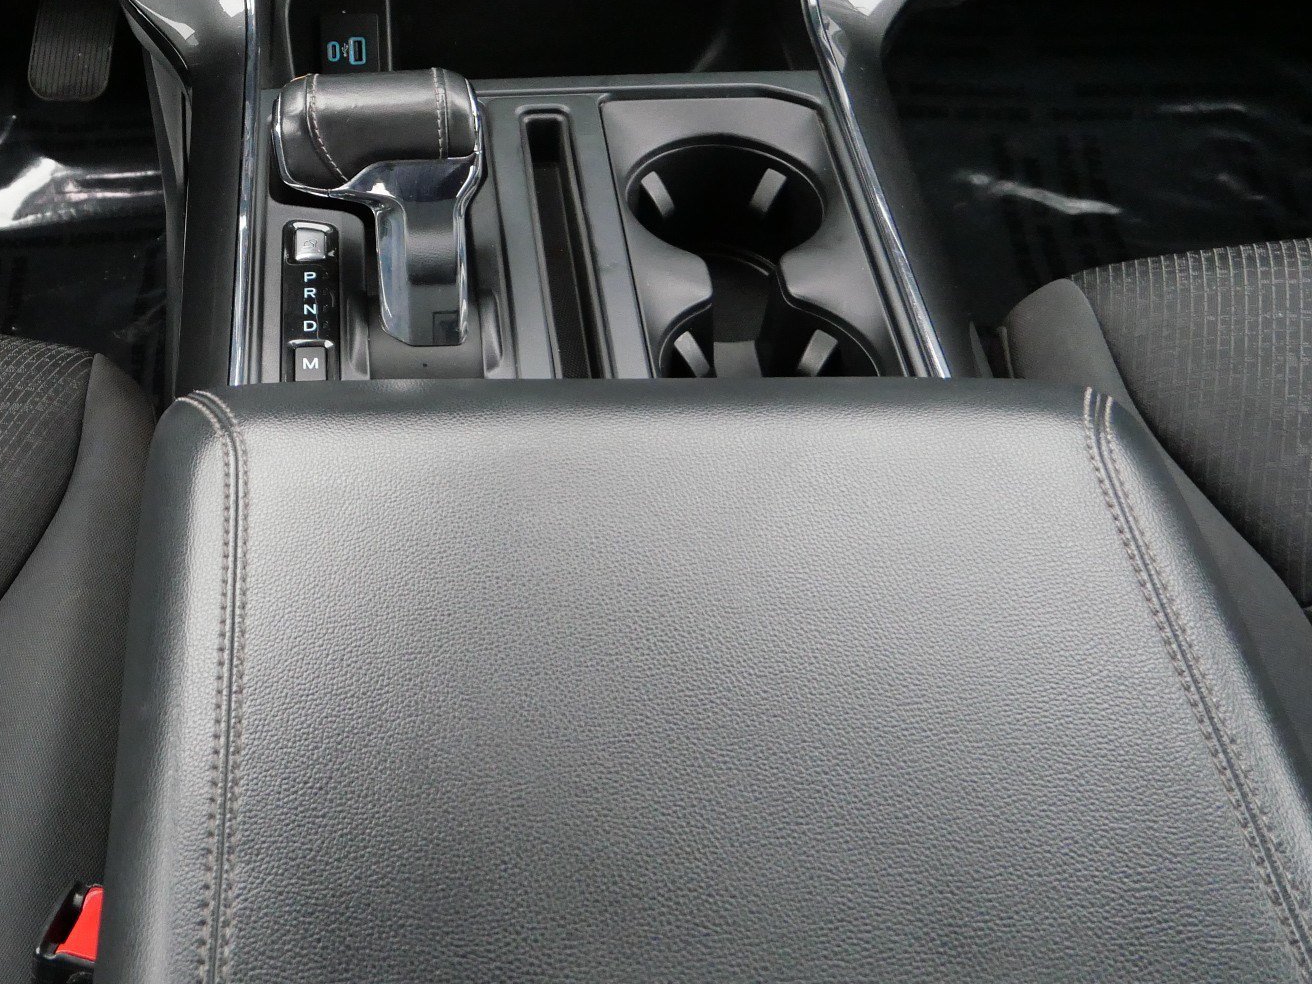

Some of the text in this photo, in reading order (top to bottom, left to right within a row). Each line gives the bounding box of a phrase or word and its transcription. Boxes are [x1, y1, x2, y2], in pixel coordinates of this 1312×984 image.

[304, 272, 316, 282] P
[304, 288, 316, 298] R
[304, 304, 316, 315] N
[304, 321, 317, 332] D
[303, 358, 318, 369] M
